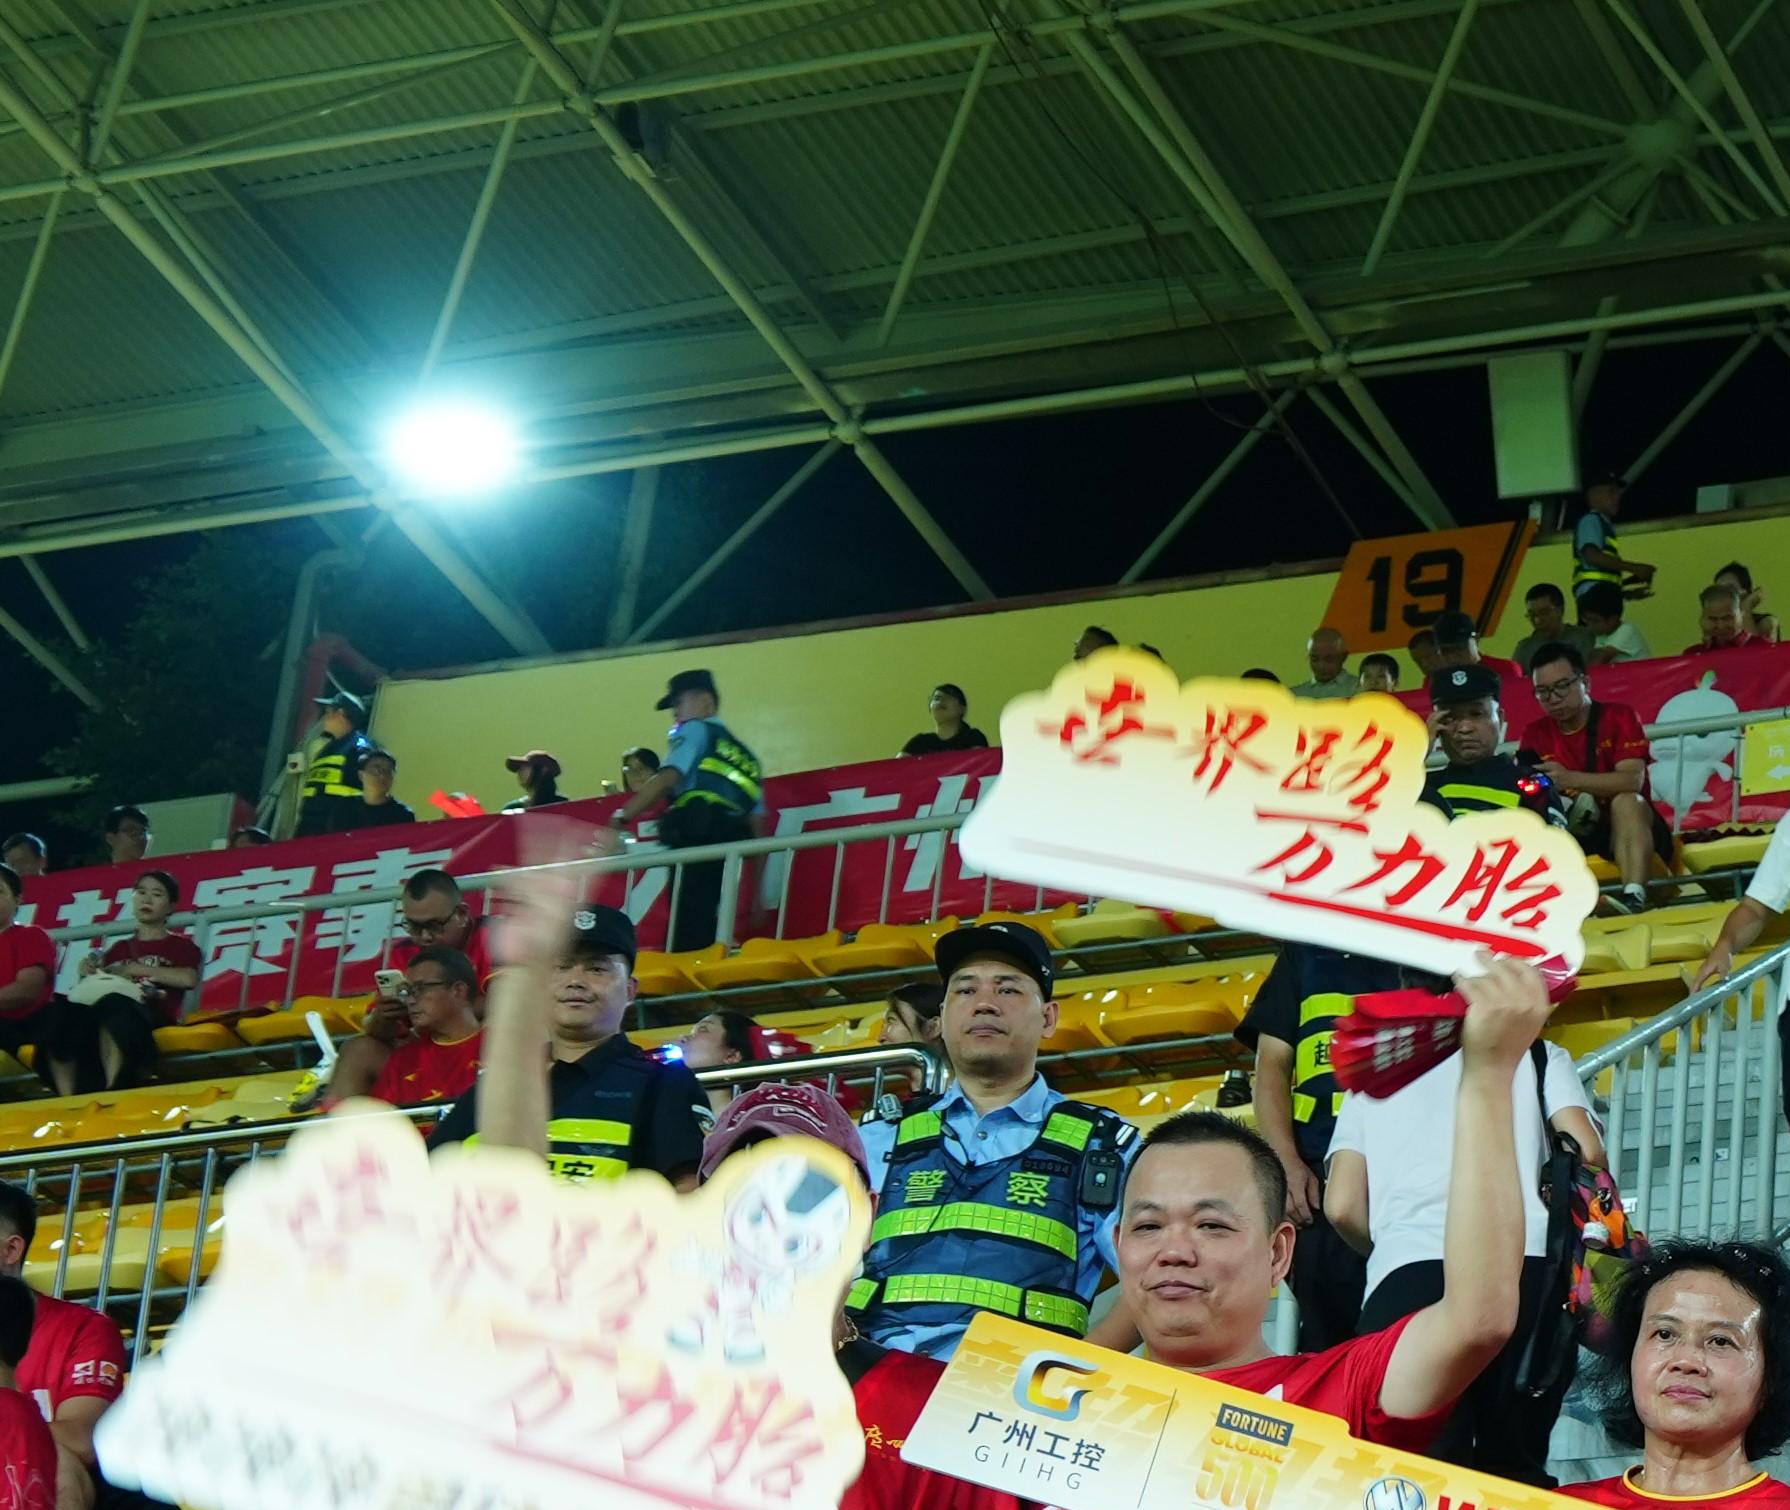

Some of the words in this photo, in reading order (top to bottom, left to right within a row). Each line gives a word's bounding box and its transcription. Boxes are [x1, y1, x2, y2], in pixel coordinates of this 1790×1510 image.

[1366, 547, 1465, 632] 19
[1038, 676, 1396, 813] 世界路
[1250, 807, 1563, 932] 万力胎
[903, 1168, 1051, 1209] 警察
[966, 1410, 1106, 1473] 广州工控
[1210, 1430, 1285, 1465] GLOBAL
[1220, 1408, 1291, 1442] FORTUNE
[973, 1444, 1083, 1492] GIIHG
